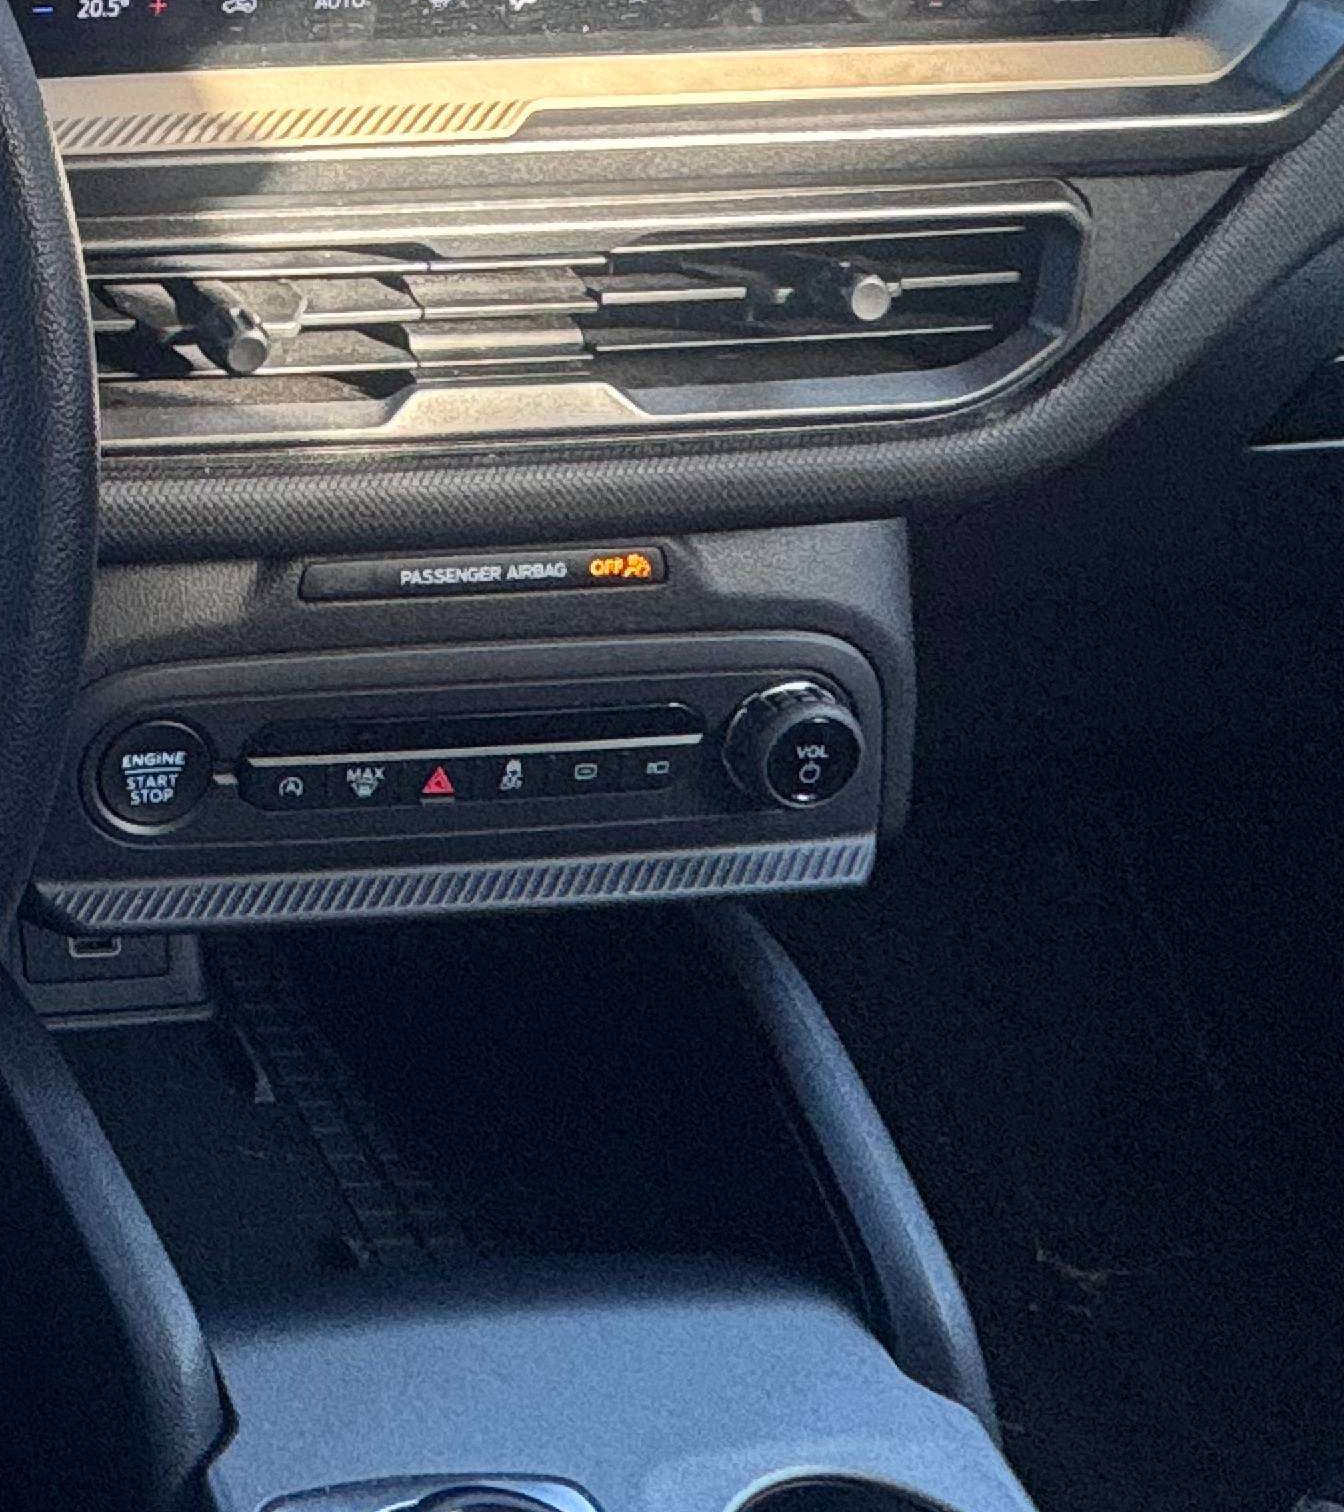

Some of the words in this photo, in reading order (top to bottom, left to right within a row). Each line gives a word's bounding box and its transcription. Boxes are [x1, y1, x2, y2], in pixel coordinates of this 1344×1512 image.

[400, 566, 502, 586] PASSENGER
[506, 561, 568, 580] AIRBAG
[590, 557, 624, 577] OFF
[121, 750, 186, 768] ENGINE
[798, 744, 829, 762] VOL
[126, 773, 179, 790] START
[346, 767, 385, 784] MAX
[130, 788, 174, 806] STOP
